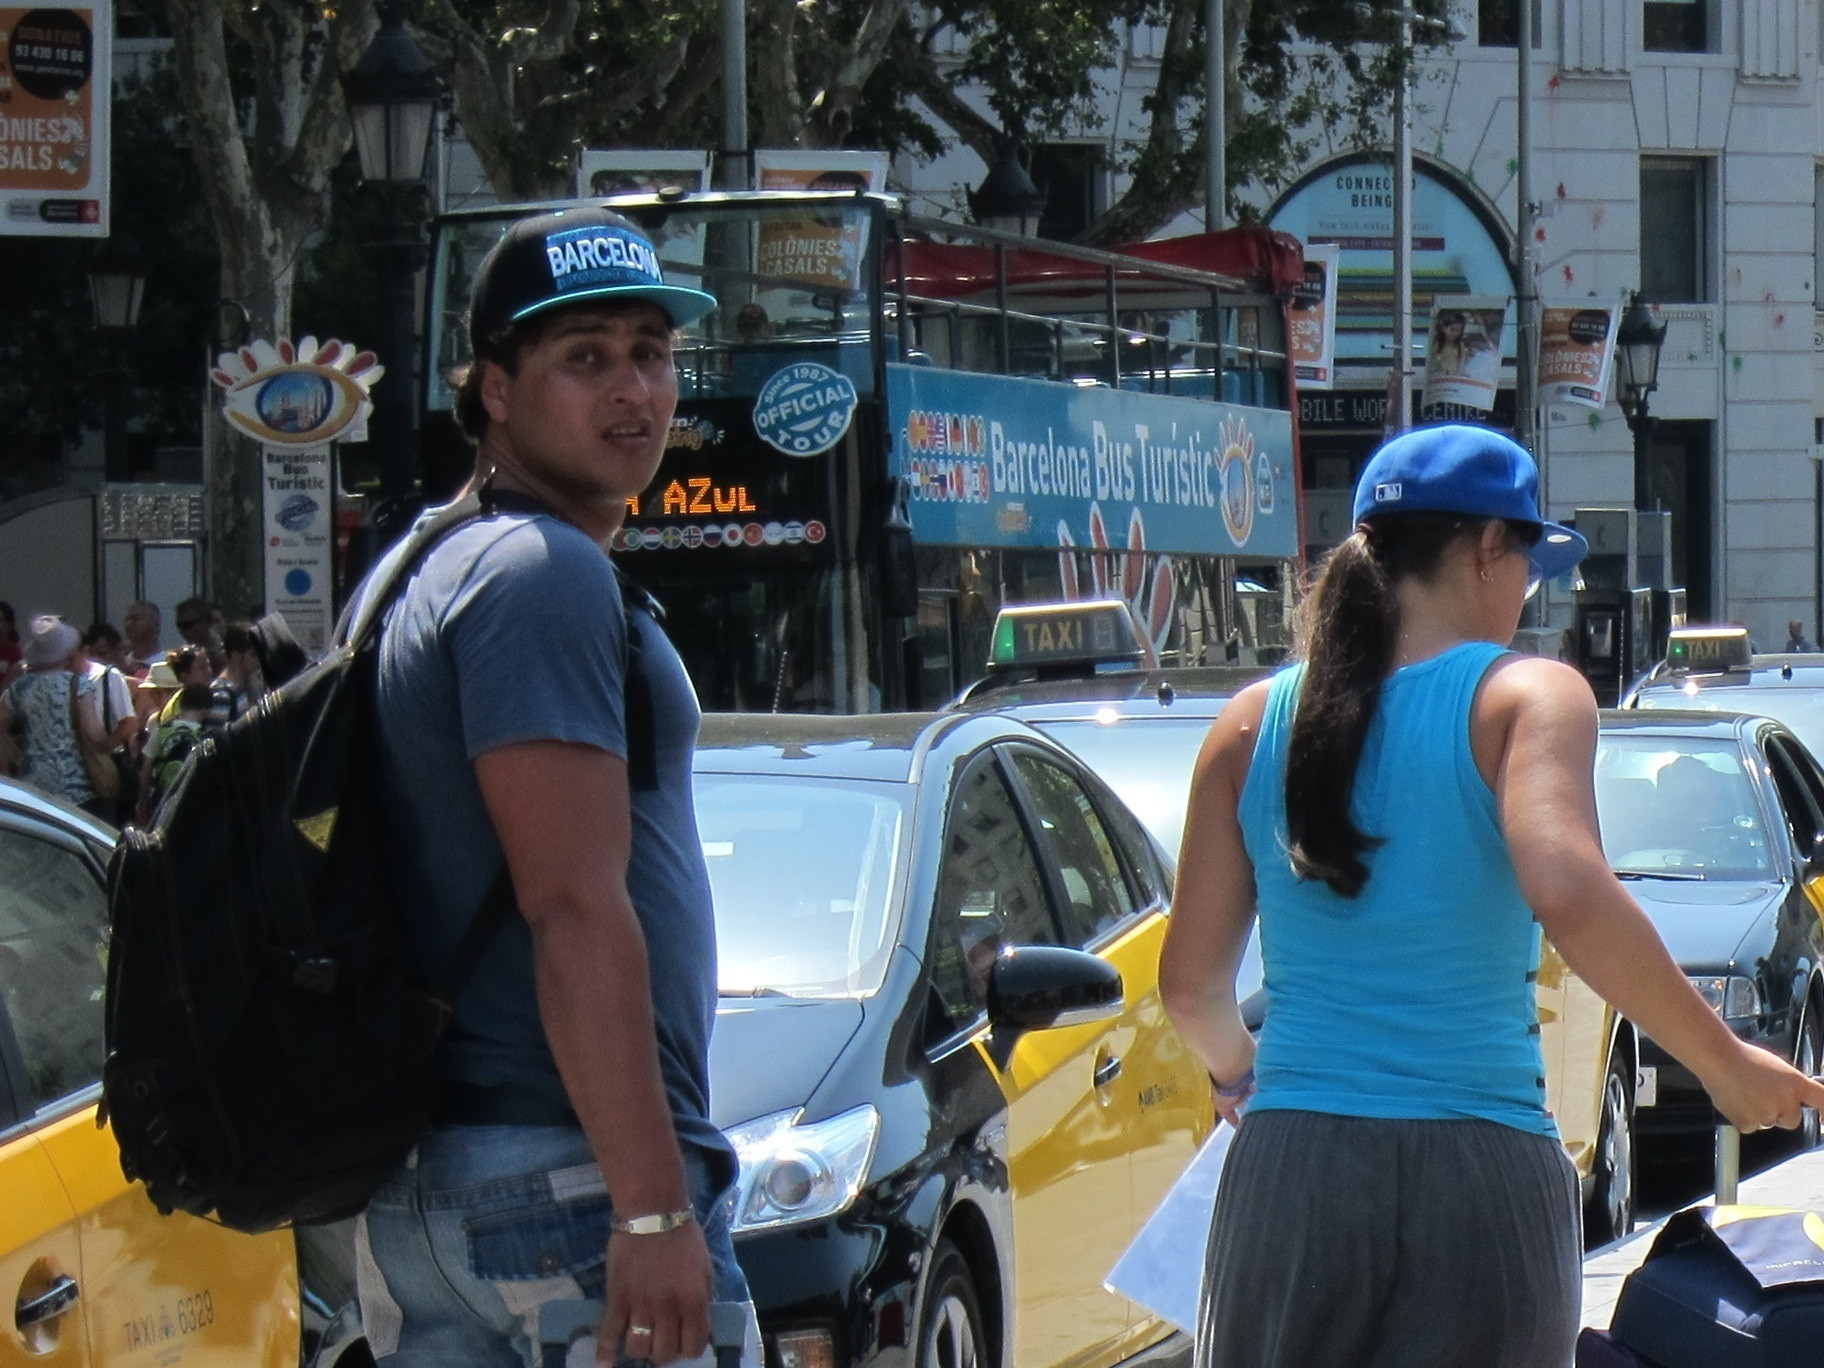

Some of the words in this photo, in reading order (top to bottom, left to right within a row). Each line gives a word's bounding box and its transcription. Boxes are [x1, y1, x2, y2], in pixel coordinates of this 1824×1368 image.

[1336, 177, 1416, 191] CONNEC
[546, 237, 663, 285] BARCELONA
[793, 367, 829, 382] 1987
[758, 384, 851, 429] OFFICIAL
[1300, 399, 1346, 422] BILE
[778, 410, 845, 451] TOUR
[283, 463, 309, 475] Bus
[990, 420, 1092, 498] Barcelona
[1092, 420, 1136, 502] Bus
[1135, 421, 1215, 508] Turístic
[1022, 619, 1084, 653] TAXI
[123, 1314, 157, 1353] TAXI
